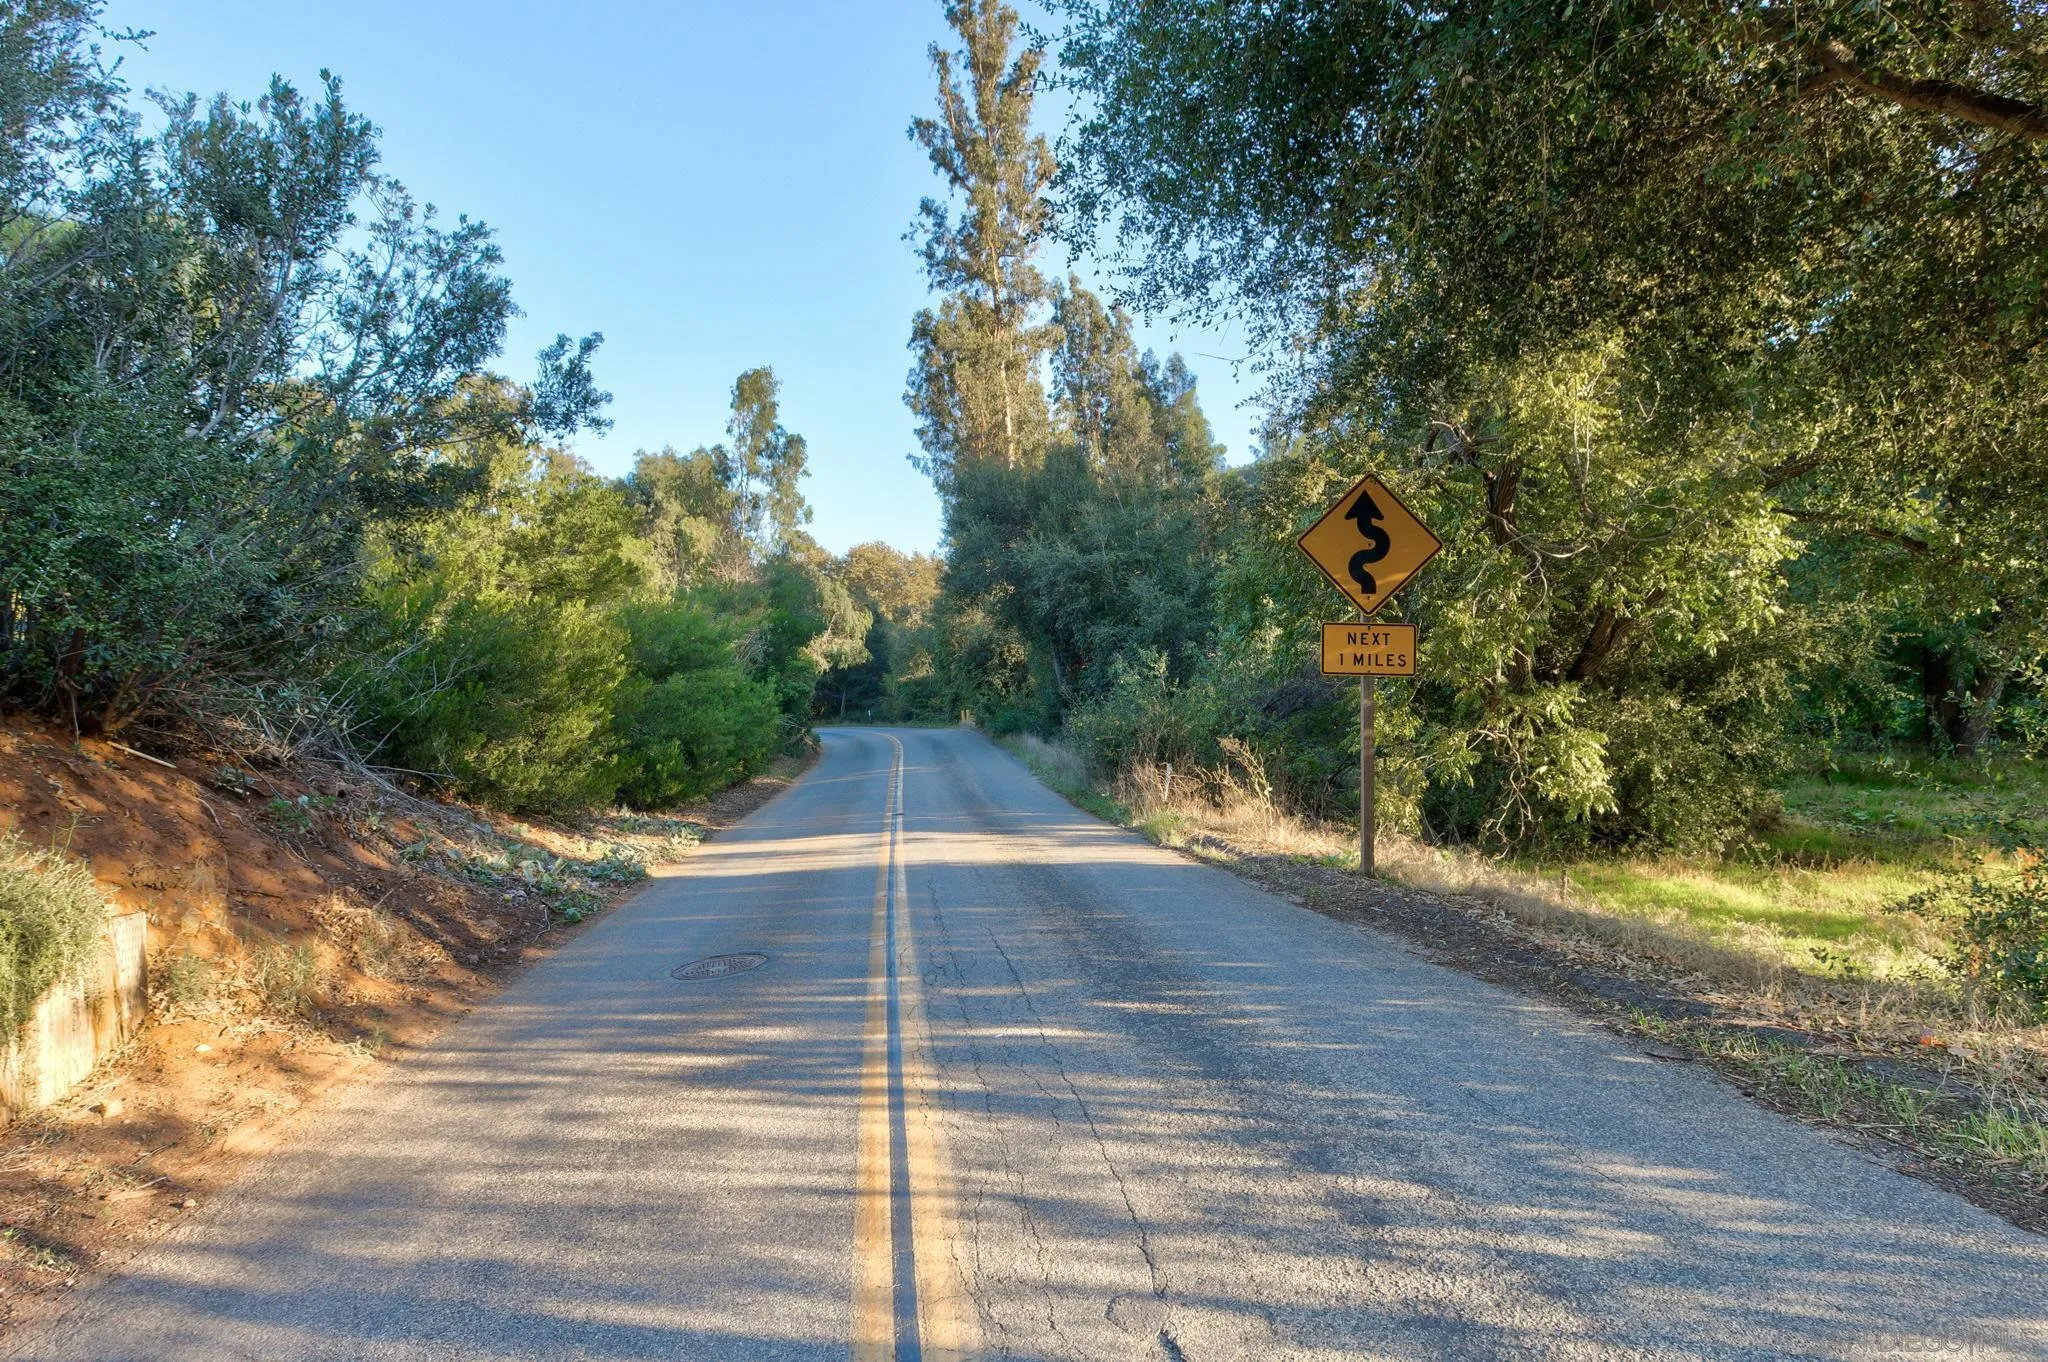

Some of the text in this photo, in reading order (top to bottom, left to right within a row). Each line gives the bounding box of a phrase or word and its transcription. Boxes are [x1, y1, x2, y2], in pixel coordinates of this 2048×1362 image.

[1347, 632, 1391, 646] NEXT
[1339, 653, 1407, 667] 1 MILES
